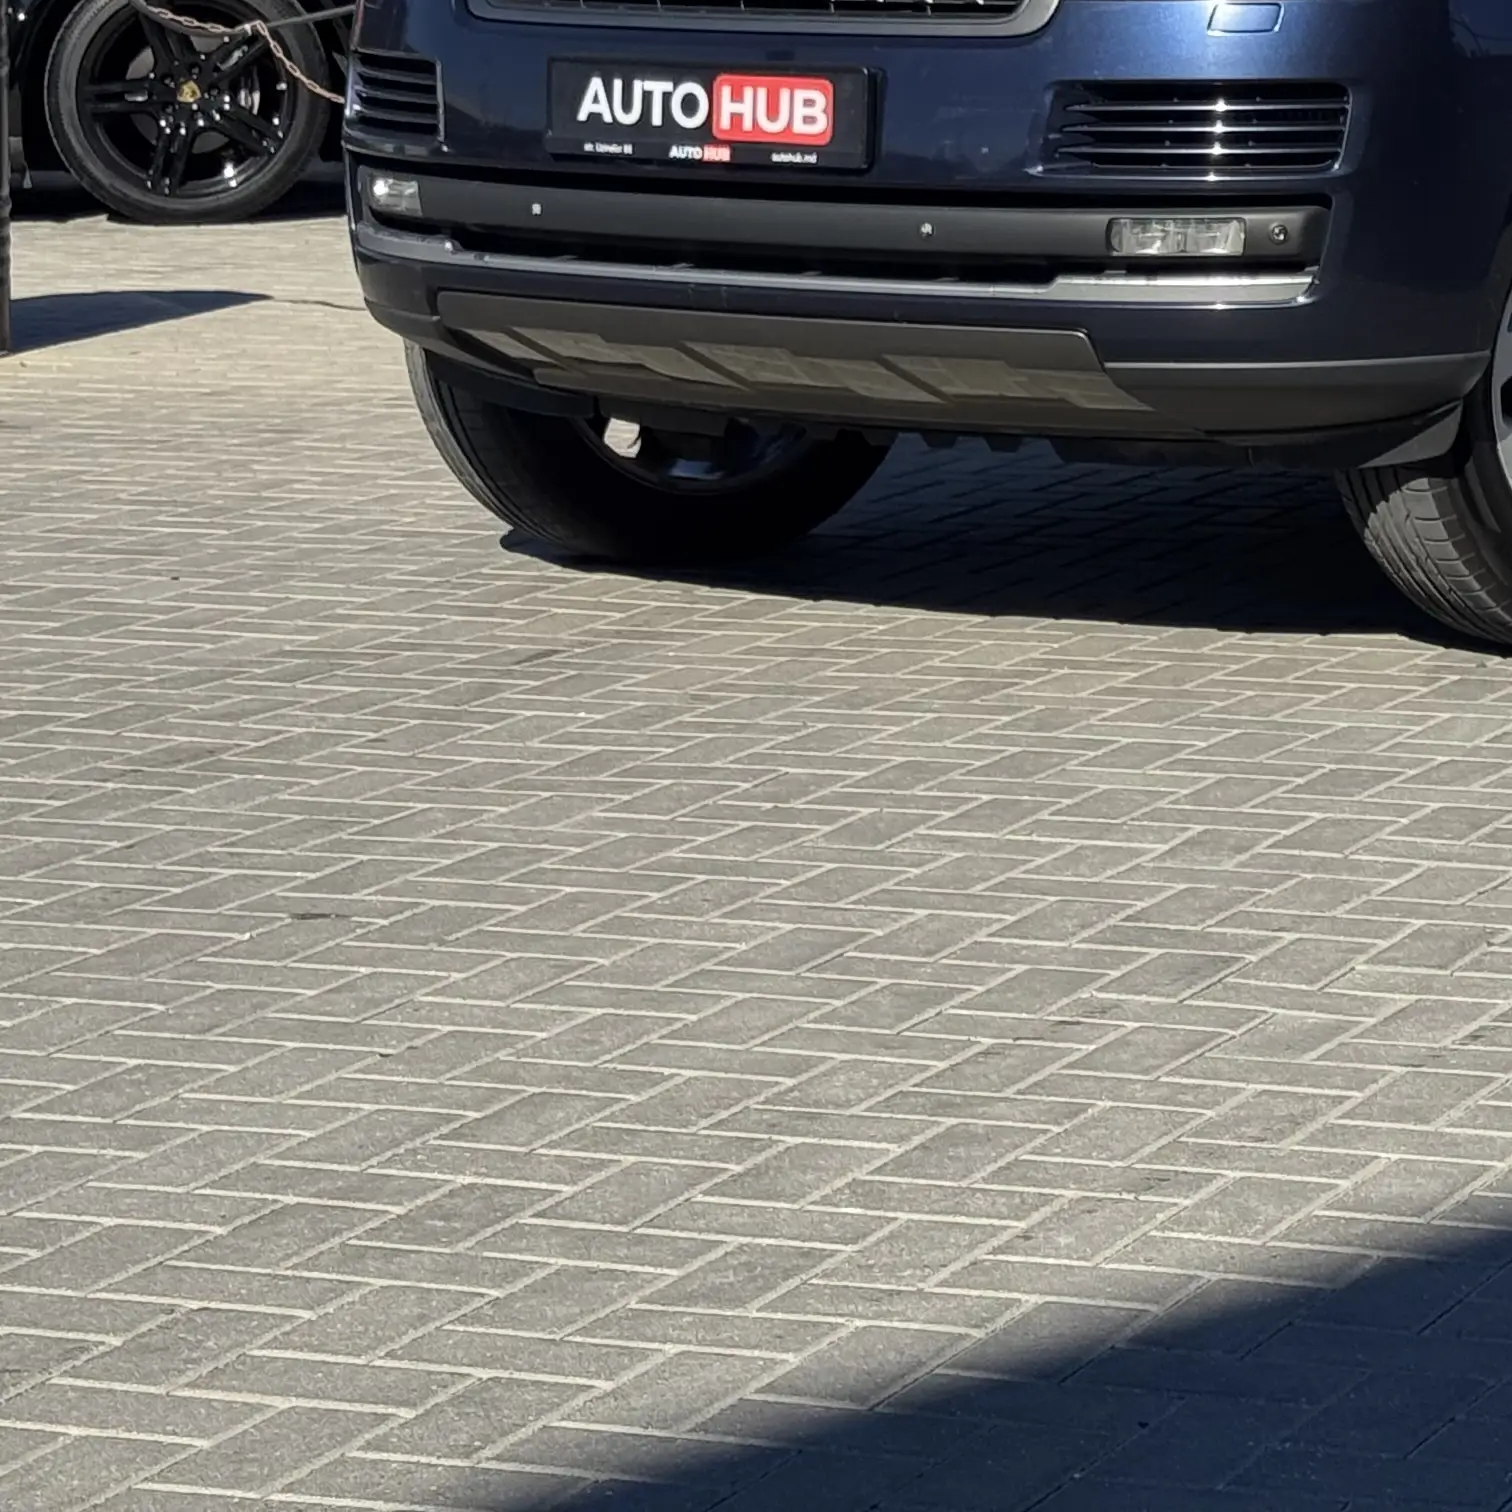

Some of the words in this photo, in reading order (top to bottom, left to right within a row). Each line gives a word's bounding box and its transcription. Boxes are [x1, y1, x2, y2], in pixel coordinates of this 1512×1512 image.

[576, 76, 709, 129] AUTO
[719, 84, 829, 135] HUB
[668, 144, 703, 160] AUTO
